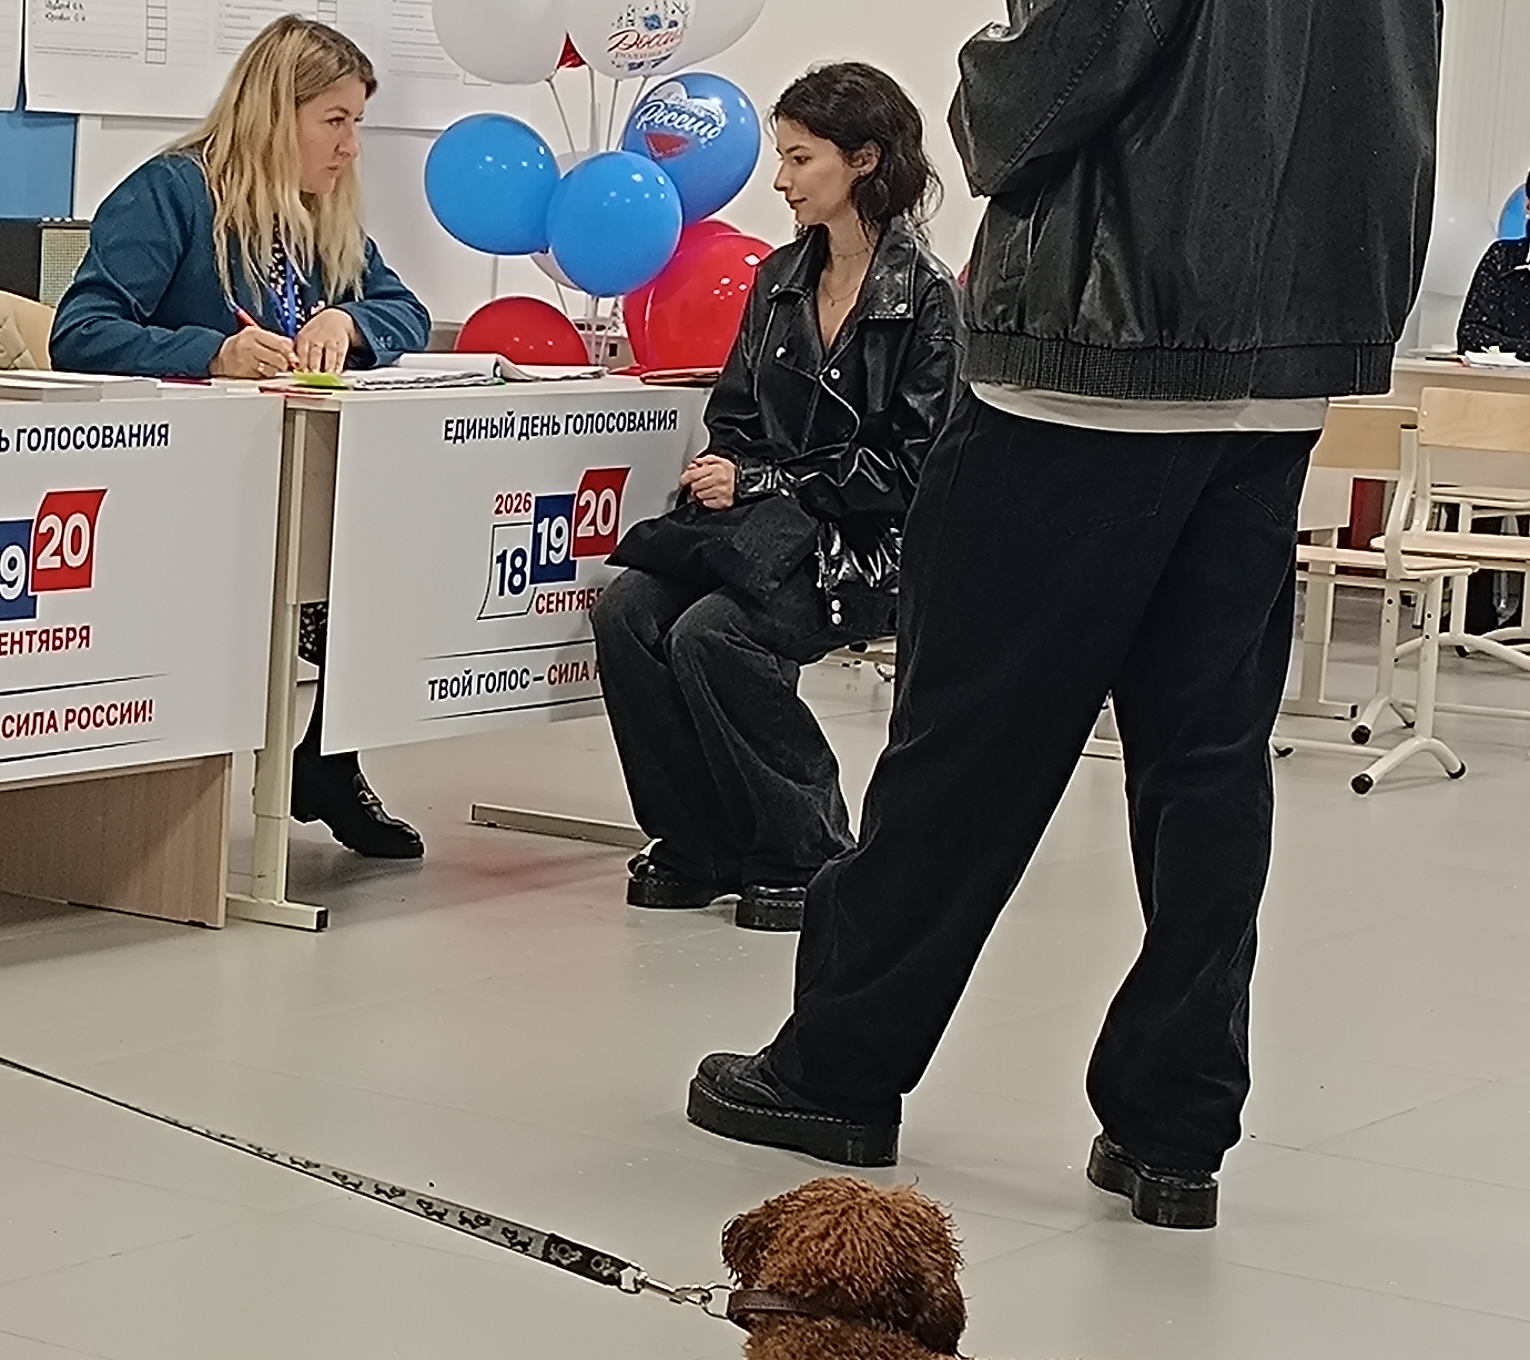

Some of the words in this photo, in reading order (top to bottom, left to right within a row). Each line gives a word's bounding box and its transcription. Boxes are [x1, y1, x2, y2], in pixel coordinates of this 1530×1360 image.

[15, 422, 170, 453] ГОЛОСОВАНИЯ
[444, 410, 514, 444] ЕДИНЫЙ
[517, 415, 561, 441] ДЕНЬ
[564, 409, 678, 436] ГОЛОСОВАНИЯ
[494, 492, 532, 515] 2026
[35, 513, 91, 570] 20
[495, 546, 528, 597] 18
[536, 515, 569, 566] 19
[576, 488, 617, 538] 20
[535, 587, 604, 614] СЕНТЯБ
[427, 668, 473, 701] ТВОЙ
[476, 667, 530, 695] ГОЛОС
[547, 660, 590, 686] СИЛА
[0, 710, 59, 739] СИЛА
[64, 699, 154, 732] РОССИИ!
